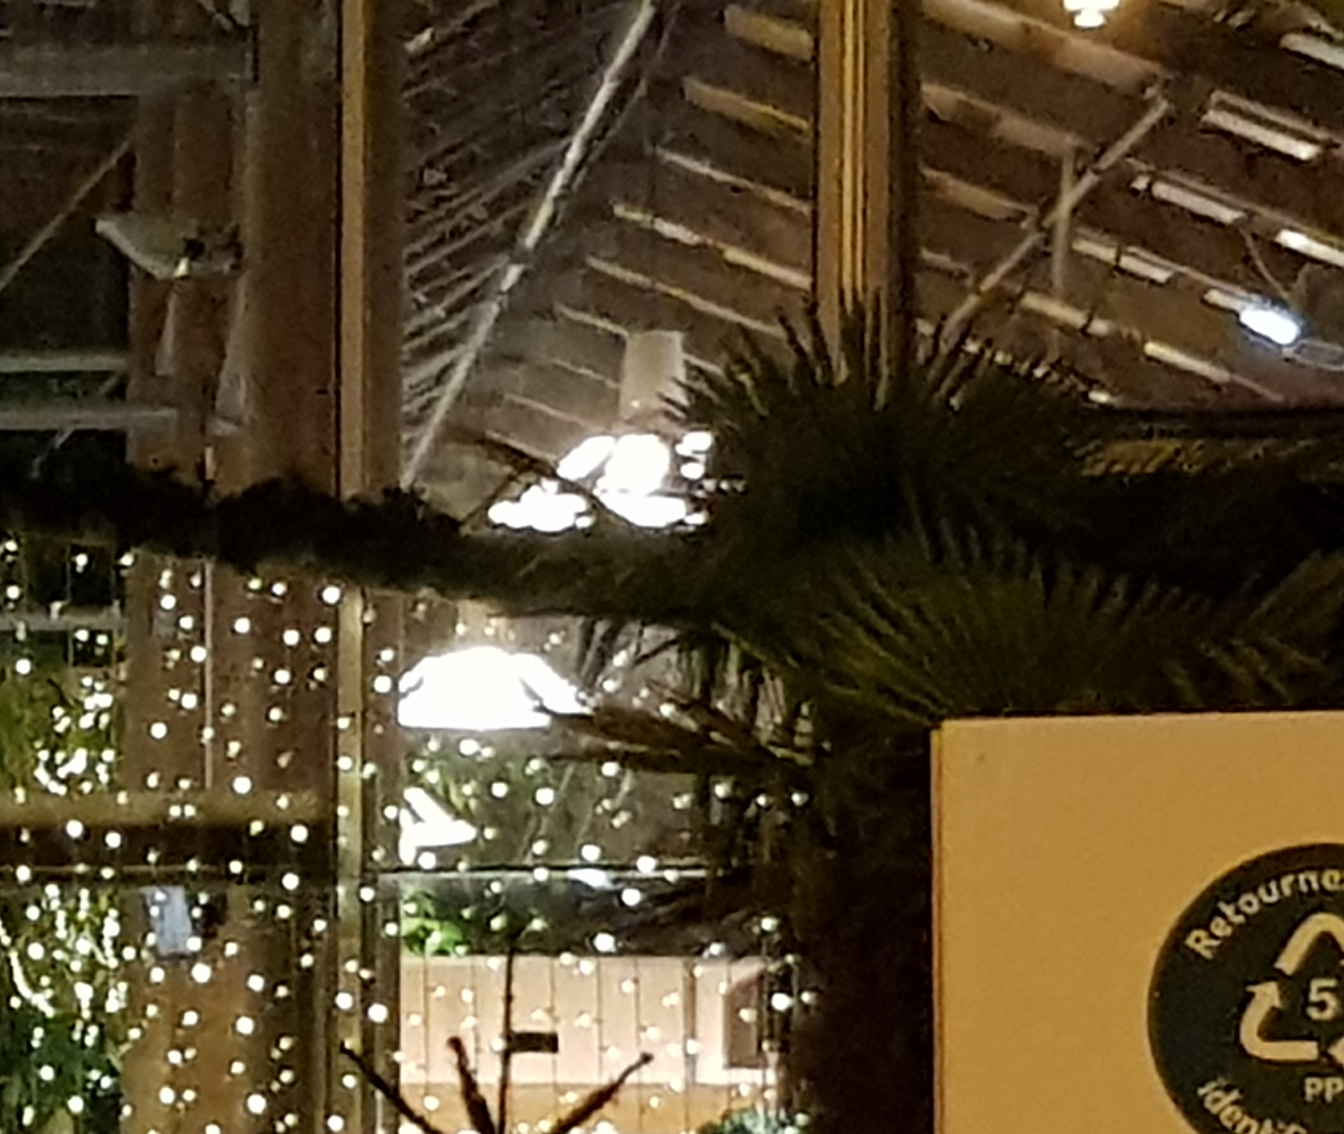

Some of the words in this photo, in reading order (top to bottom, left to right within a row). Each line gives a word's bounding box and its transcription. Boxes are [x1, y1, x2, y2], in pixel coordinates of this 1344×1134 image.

[1185, 869, 1344, 960] Retourne
[1305, 977, 1338, 1020] 5
[1304, 1075, 1344, 1103] PP
